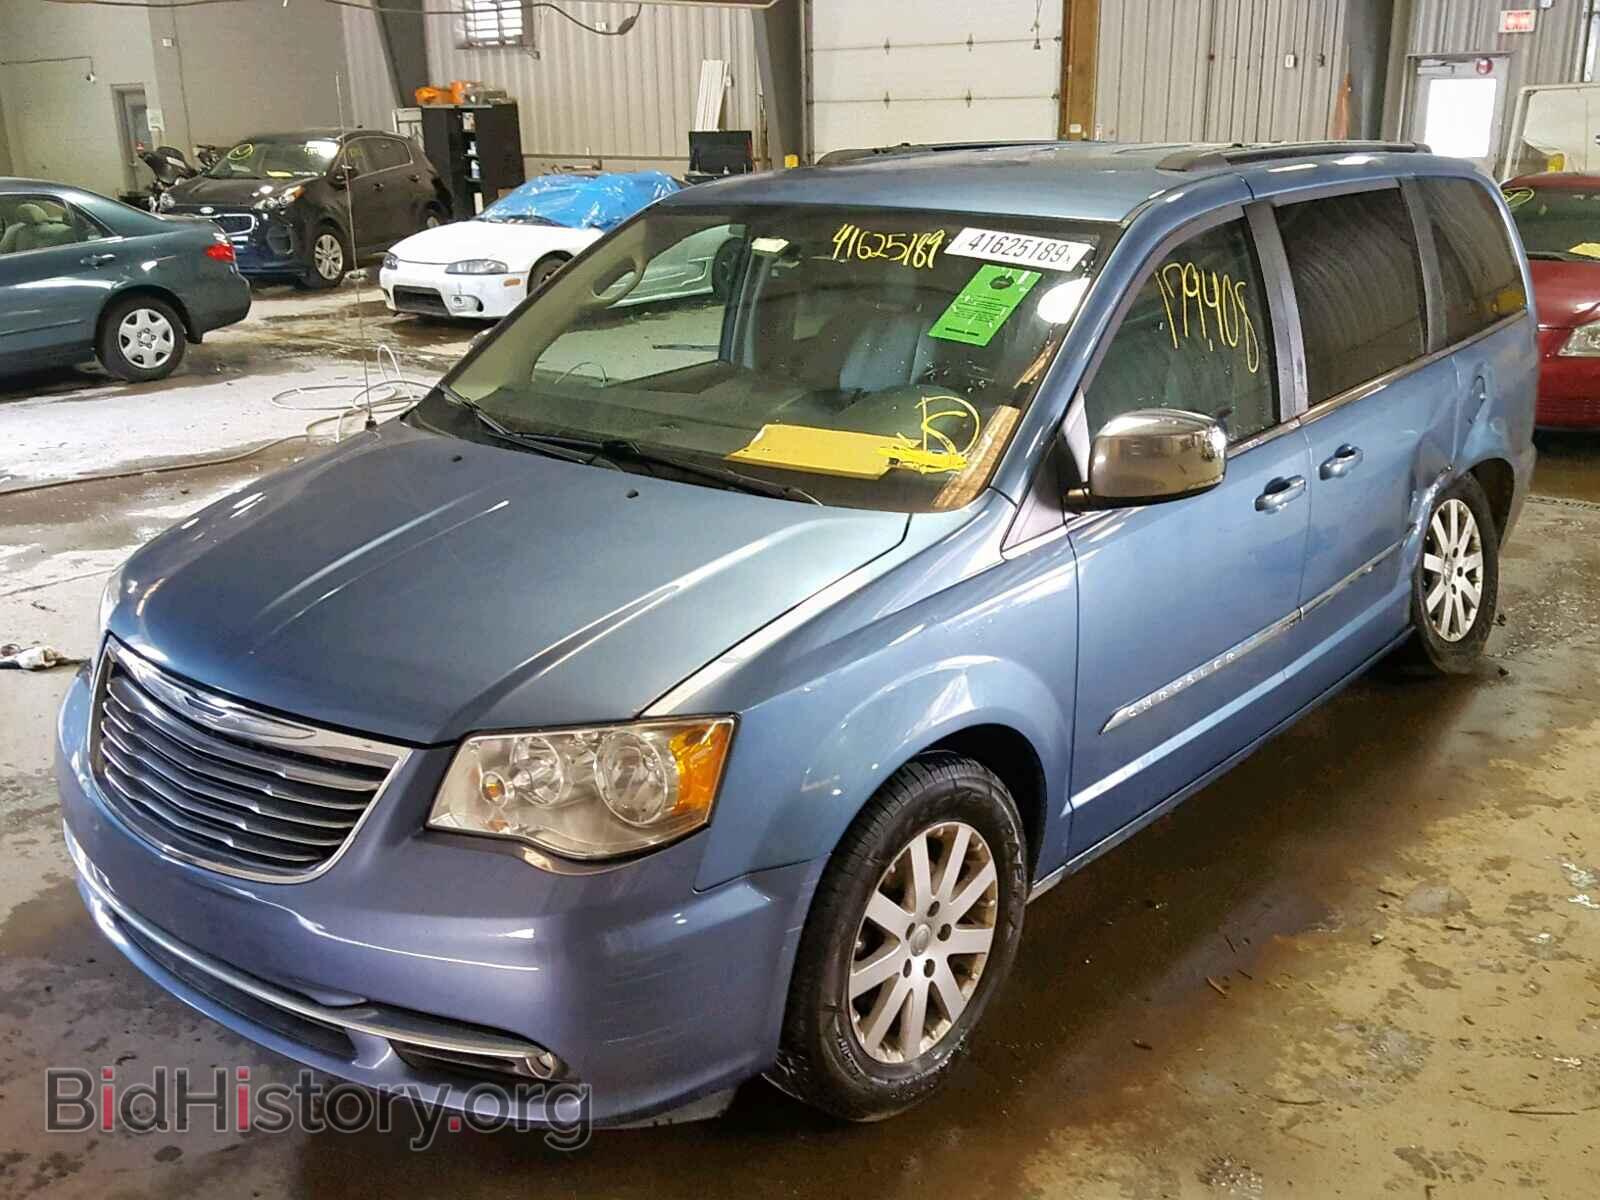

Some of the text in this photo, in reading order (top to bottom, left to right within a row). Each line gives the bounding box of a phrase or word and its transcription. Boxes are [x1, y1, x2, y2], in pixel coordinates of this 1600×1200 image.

[832, 223, 945, 269] 41625189
[968, 232, 1069, 263] 41625189
[1127, 652, 1235, 717] CHRYSLER
